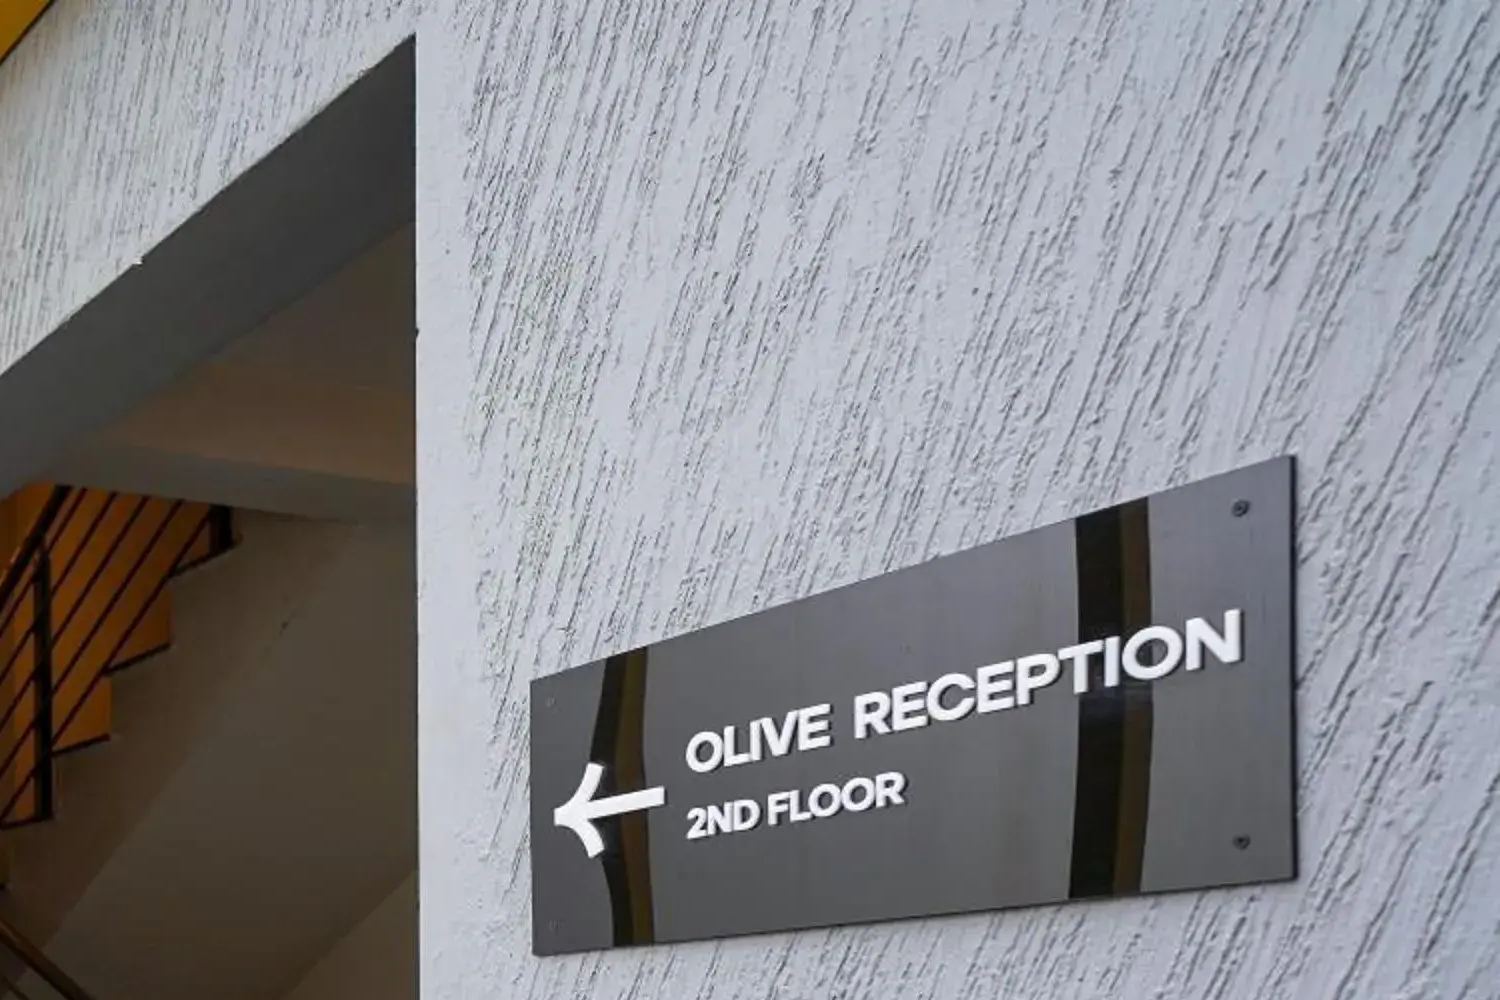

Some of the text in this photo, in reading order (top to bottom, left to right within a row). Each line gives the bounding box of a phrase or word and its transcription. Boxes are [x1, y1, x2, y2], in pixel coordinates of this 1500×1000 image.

[685, 608, 1242, 773] OLIVE RECEPTION
[686, 771, 905, 840] 2ND FLOOR
